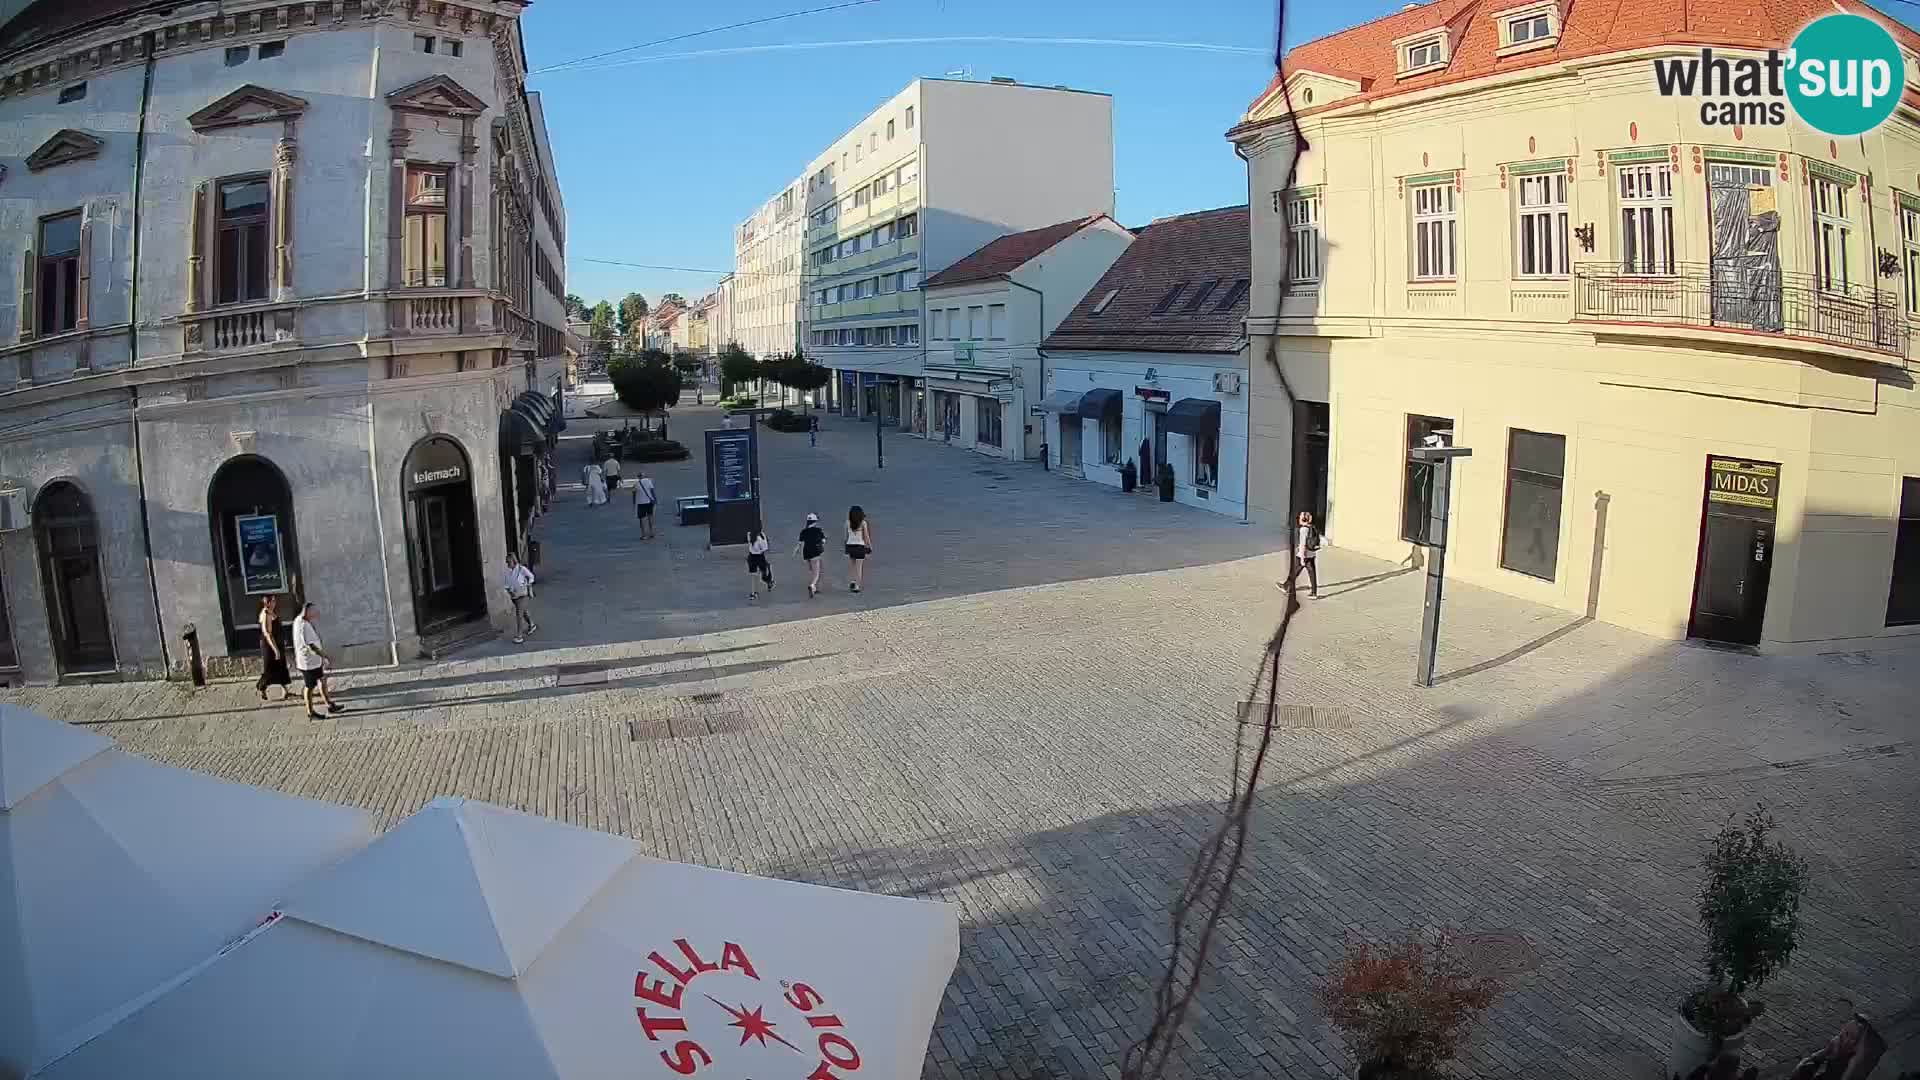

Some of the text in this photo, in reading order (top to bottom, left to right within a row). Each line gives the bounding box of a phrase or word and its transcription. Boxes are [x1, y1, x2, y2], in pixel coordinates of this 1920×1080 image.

[413, 466, 460, 484] telemach
[1715, 473, 1769, 494] MIDAS
[634, 938, 760, 1075] STELLA
